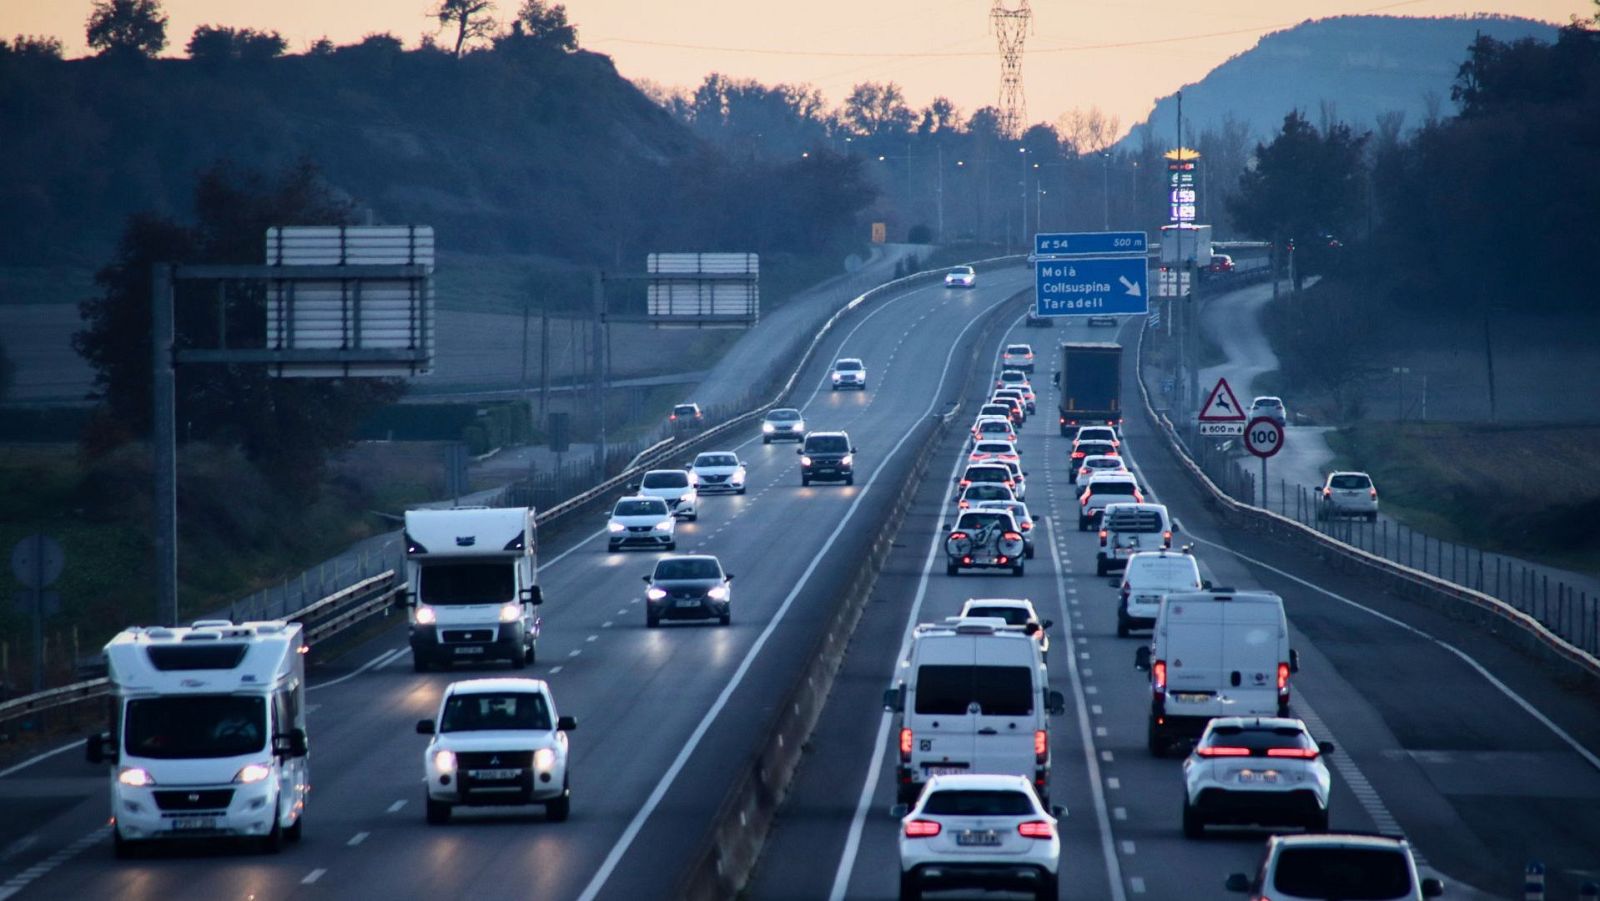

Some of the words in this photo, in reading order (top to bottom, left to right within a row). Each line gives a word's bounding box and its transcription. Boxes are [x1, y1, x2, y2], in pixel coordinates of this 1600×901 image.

[1053, 240, 1068, 249] 54
[1113, 238, 1131, 247] 500
[1042, 267, 1077, 278] Moià
[1043, 282, 1111, 294] Collsuspina
[1043, 298, 1103, 309] Taradell
[1209, 425, 1226, 433] 600
[1251, 430, 1277, 444] 100
